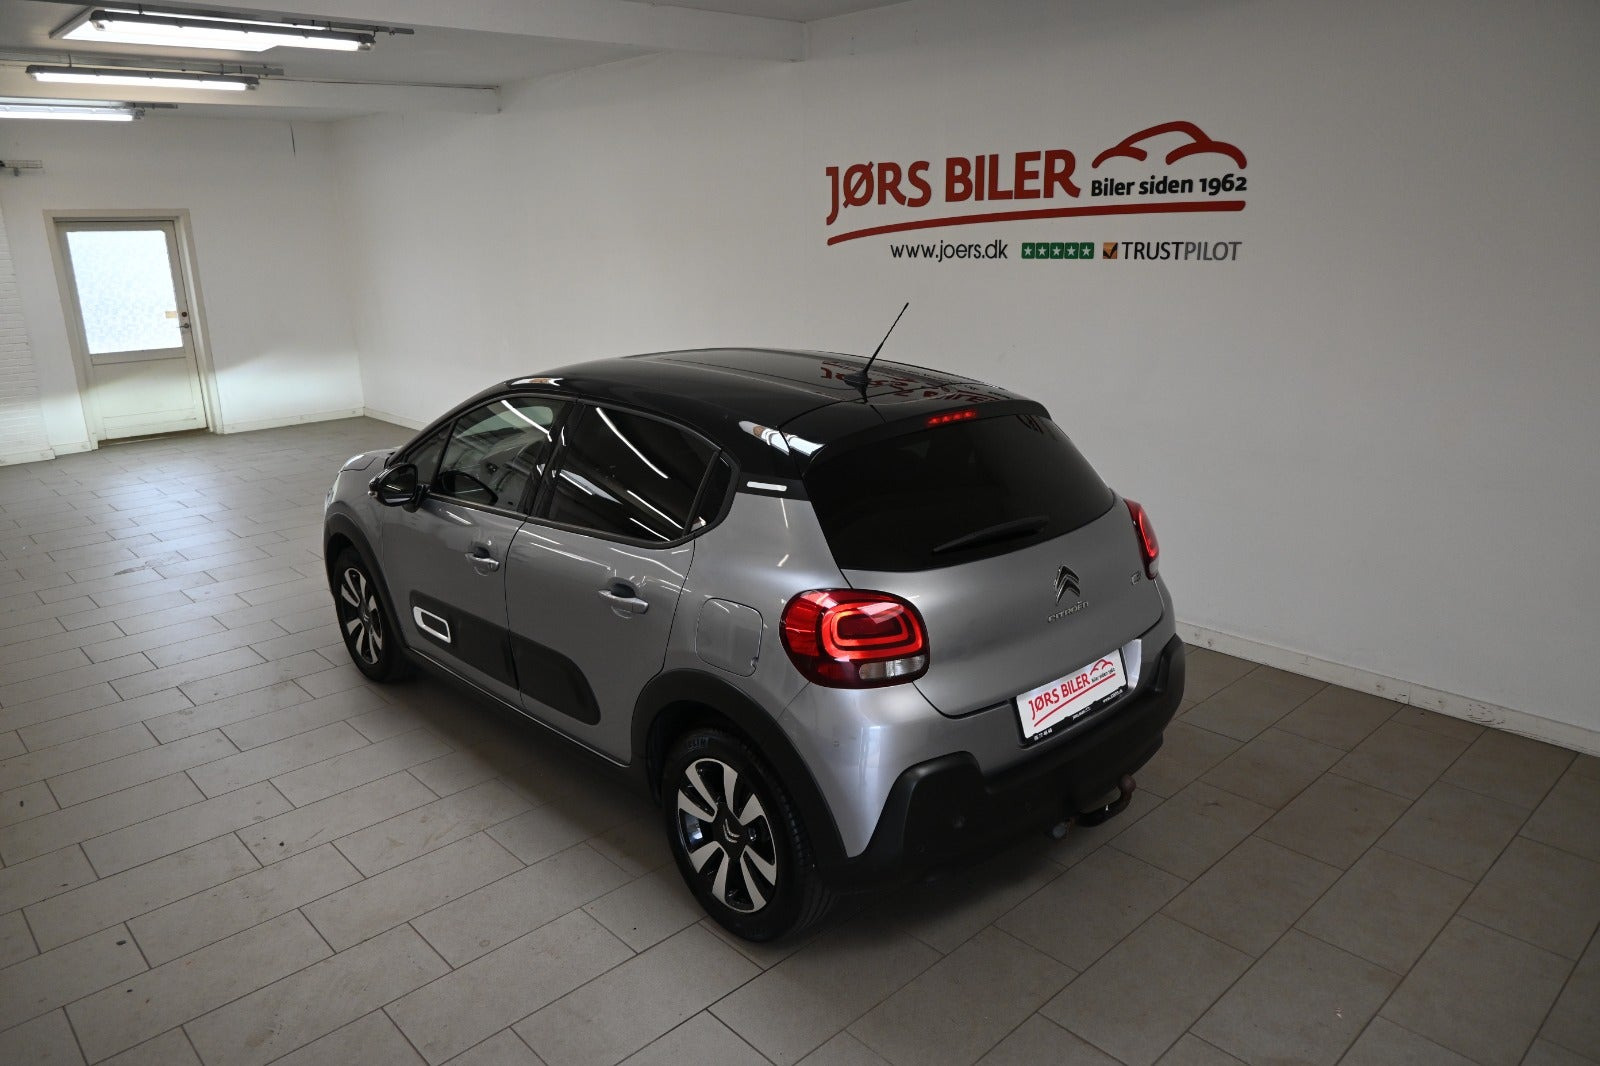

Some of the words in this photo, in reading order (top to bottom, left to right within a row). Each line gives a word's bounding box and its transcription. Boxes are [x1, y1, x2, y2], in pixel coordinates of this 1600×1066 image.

[826, 160, 932, 226] JØRS
[945, 149, 1081, 203] BILER
[1091, 177, 1135, 197] Biler
[1138, 175, 1194, 195] siden
[1199, 173, 1247, 196] 1962
[890, 239, 1008, 262] www.joers.dk
[1121, 241, 1243, 261] TRUSTPILOT
[1028, 687, 1060, 721] JØRS
[1061, 672, 1091, 698] BILER
